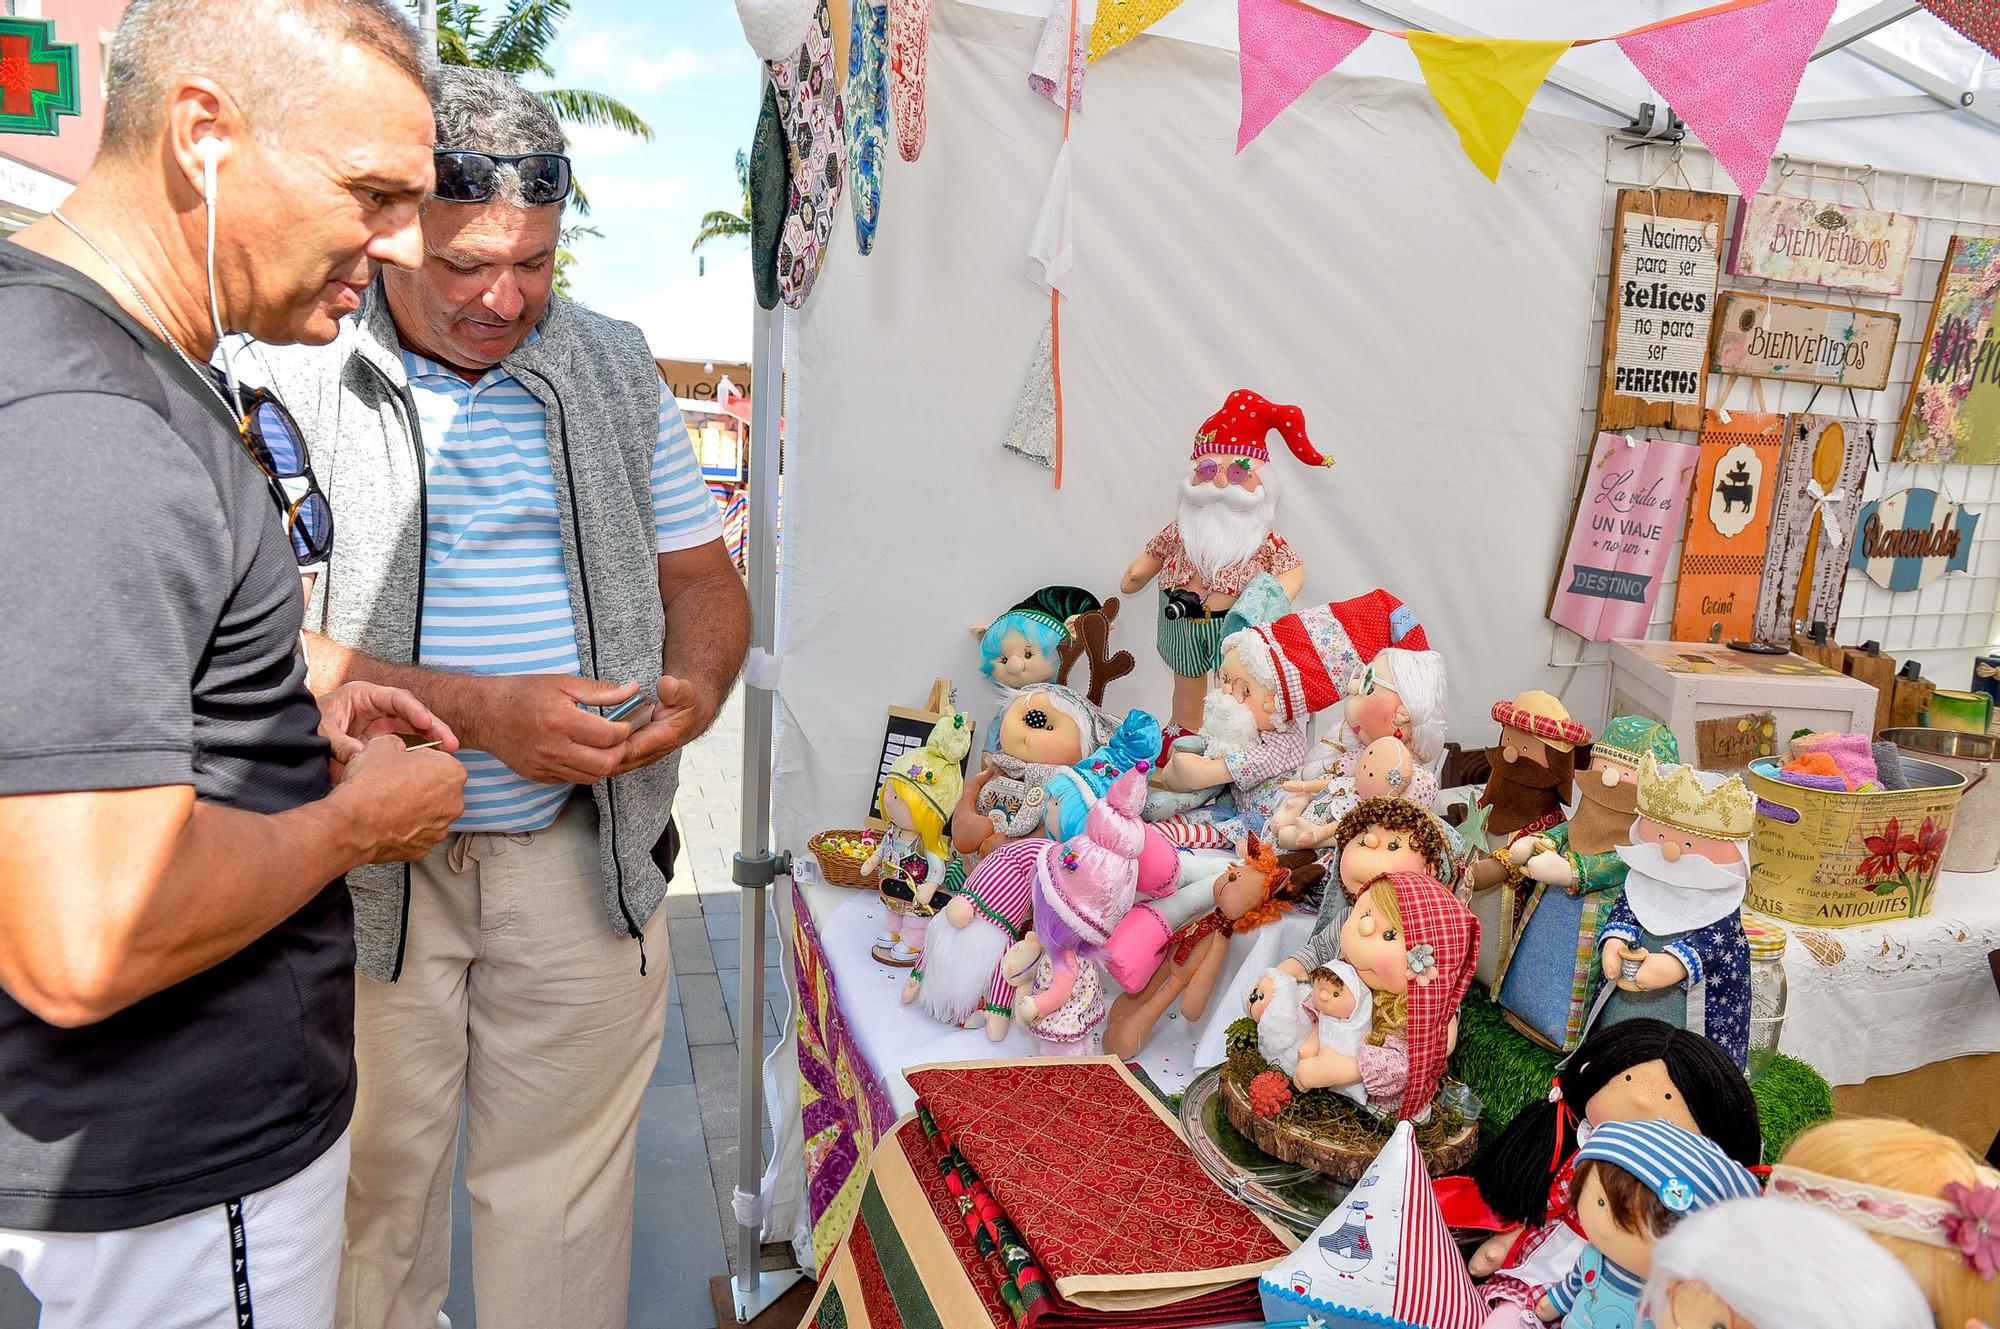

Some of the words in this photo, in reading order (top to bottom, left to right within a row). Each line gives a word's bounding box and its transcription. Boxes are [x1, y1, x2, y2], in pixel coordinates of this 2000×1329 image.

[1641, 223, 1703, 253] Nacimos
[1769, 223, 1890, 269] BIENVENIDOS
[1635, 256, 1667, 276] para
[1679, 259, 1697, 277] ser
[1624, 280, 1706, 313] felices
[1634, 318, 1652, 335] no
[1660, 320, 1694, 340] para
[1647, 344, 1667, 361] ser
[1747, 326, 1868, 370] BIENVENIDOS
[1615, 366, 1698, 394] PERFECTOS
[1595, 469, 1635, 513] La
[1629, 477, 1664, 507] vida
[1660, 497, 1672, 510] es
[1592, 514, 1615, 533] UN
[1620, 519, 1663, 541] VIAJE
[1601, 539, 1620, 551] no
[1623, 542, 1641, 555] un
[1574, 571, 1643, 597] DESTINO
[1787, 850, 1815, 862] Denis
[1816, 896, 1909, 918] ANTIQUITES
[1821, 890, 1831, 899] de
